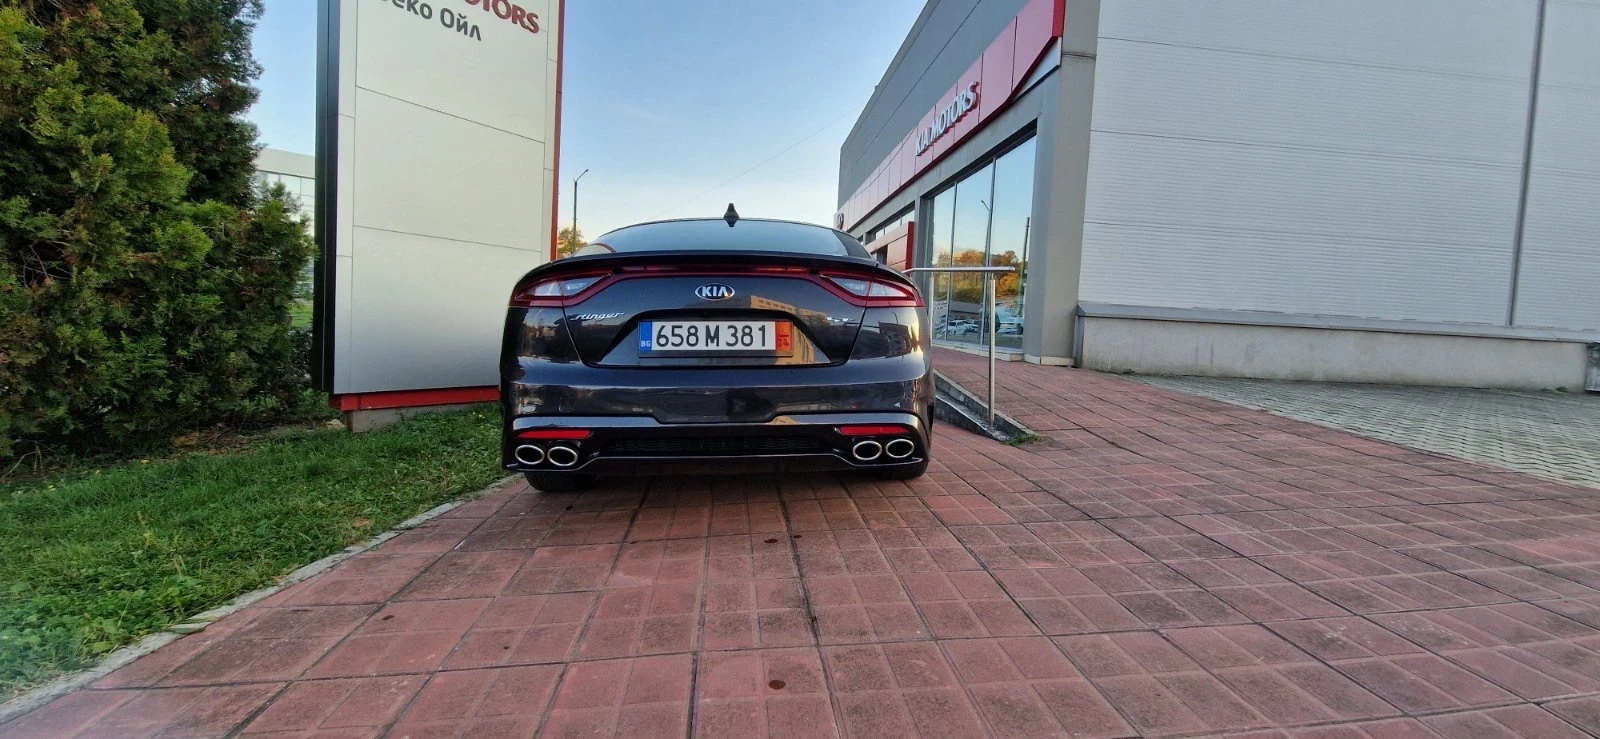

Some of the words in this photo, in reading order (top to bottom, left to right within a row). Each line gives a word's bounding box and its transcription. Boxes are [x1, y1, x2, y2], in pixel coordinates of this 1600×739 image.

[380, 0, 433, 20] еко
[439, 7, 482, 42] Ойл
[464, 0, 540, 34] TORS
[915, 127, 931, 155] KIA
[931, 81, 979, 143] MOTORS
[701, 286, 729, 297] KIA
[640, 340, 652, 348] BG
[656, 324, 700, 348] 658
[705, 324, 720, 348] M
[725, 324, 766, 348] 381
